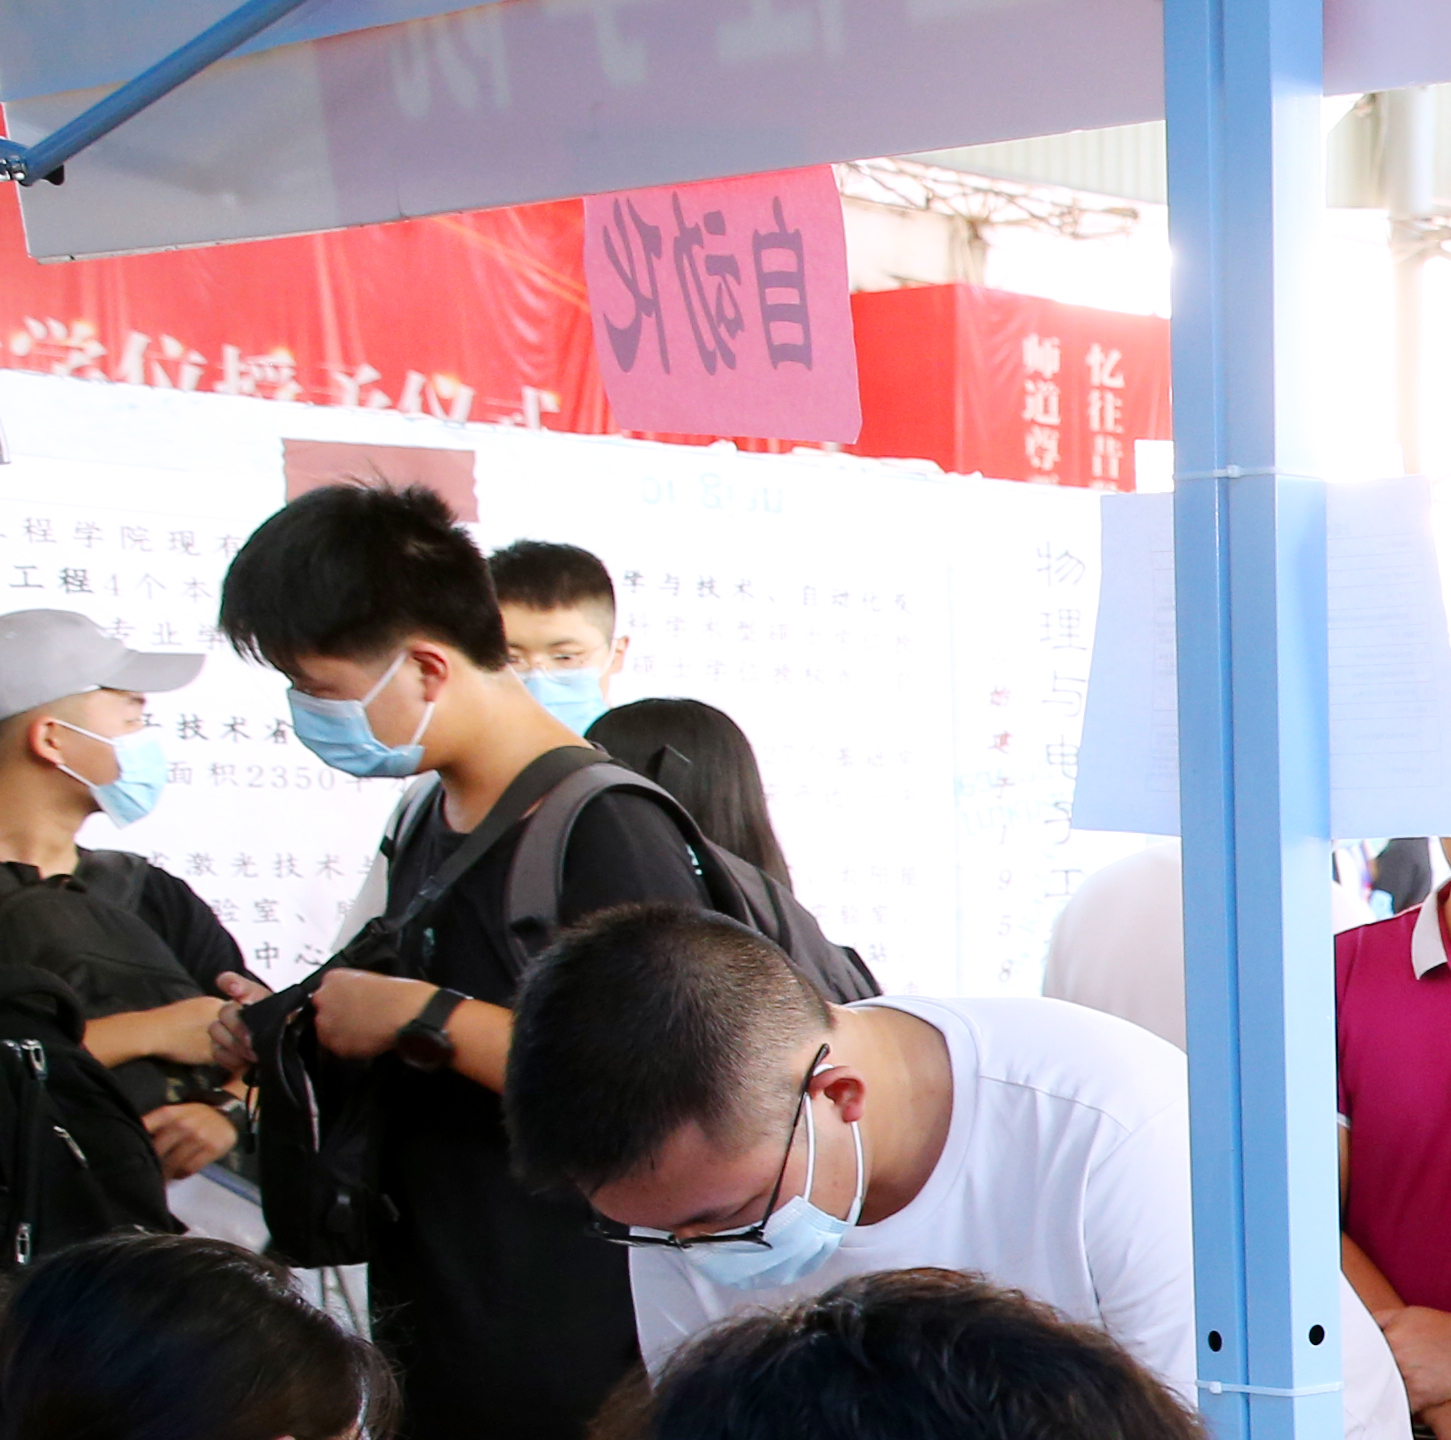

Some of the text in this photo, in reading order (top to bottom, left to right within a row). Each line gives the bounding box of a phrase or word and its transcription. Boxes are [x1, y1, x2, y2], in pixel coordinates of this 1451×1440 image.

[1021, 332, 1061, 485] 师道尊
[1085, 342, 1126, 492] 忆往昔
[0, 516, 243, 560] 程学院现有
